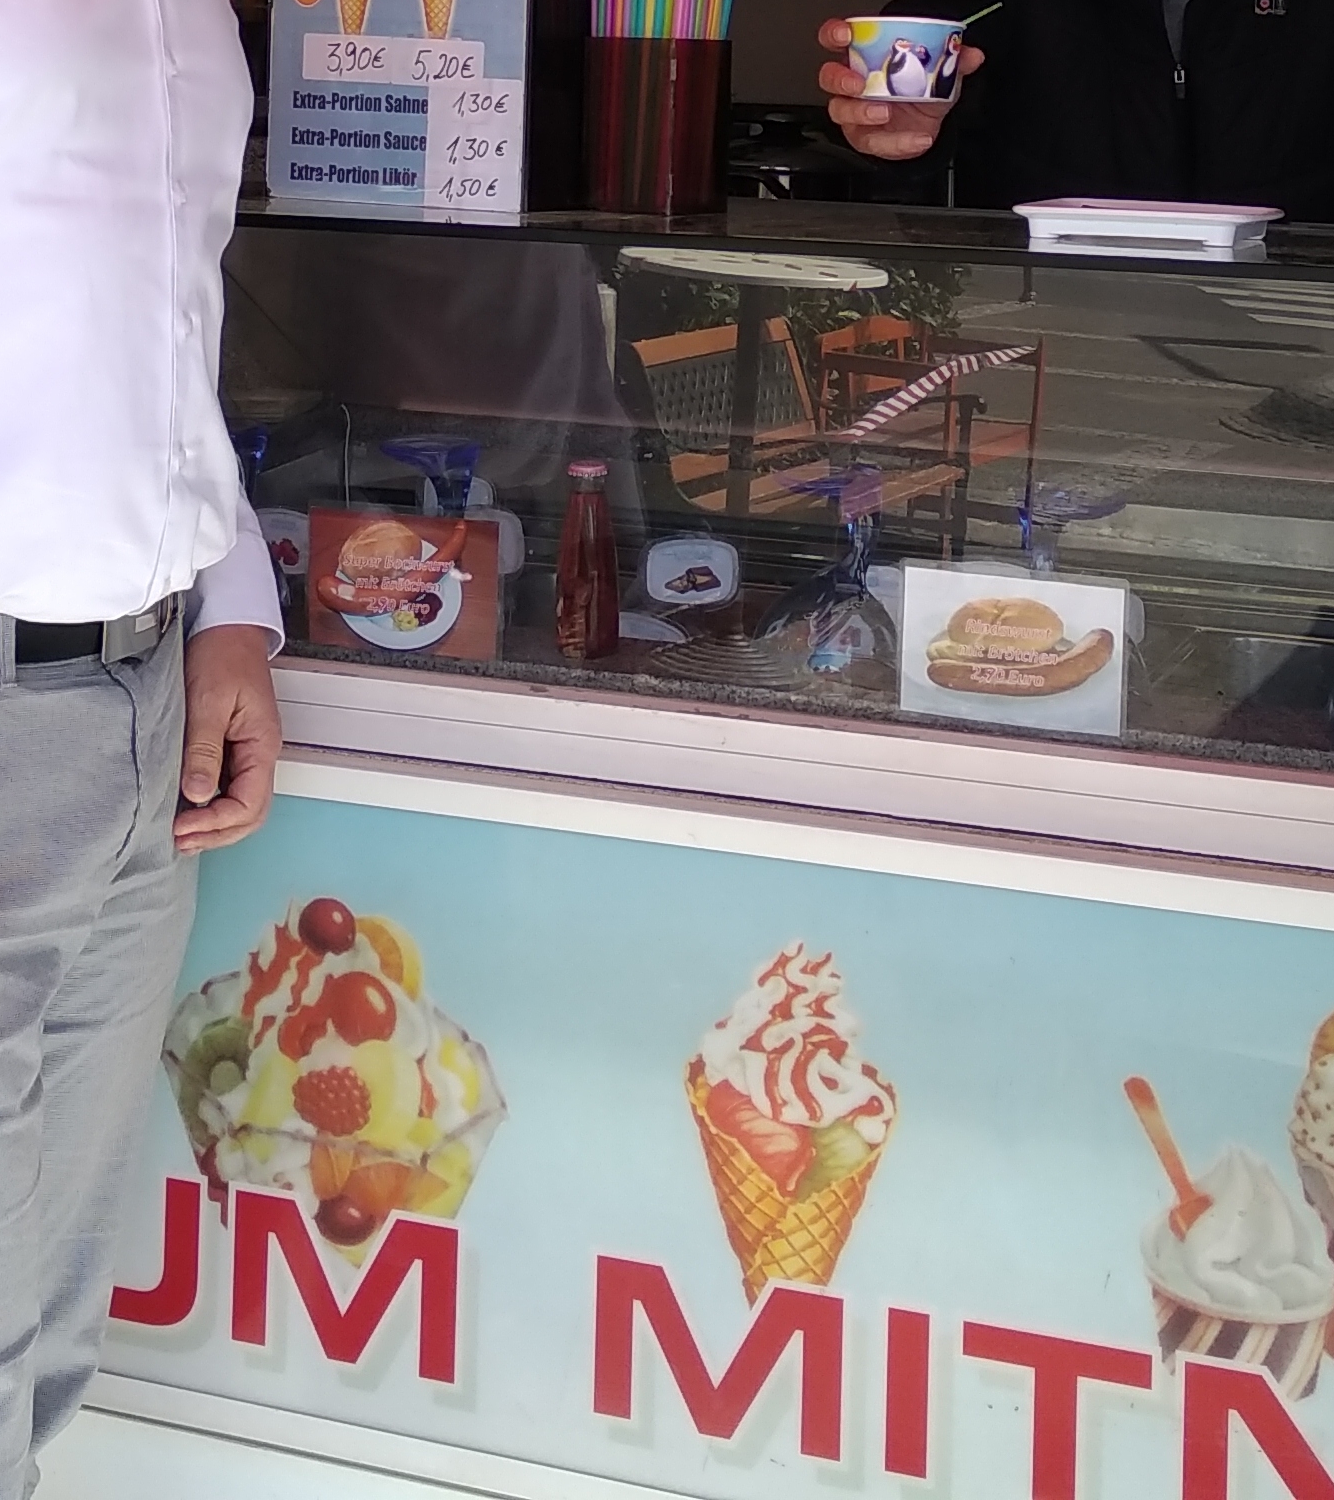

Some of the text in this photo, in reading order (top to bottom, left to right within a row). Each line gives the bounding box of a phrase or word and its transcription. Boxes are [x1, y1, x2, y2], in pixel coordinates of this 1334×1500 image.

[292, 90, 382, 114] Extra-Portion
[385, 94, 429, 115] Sahne
[290, 126, 381, 150] Extra-Portion
[383, 131, 427, 152] Sauce
[289, 162, 379, 186] Extra-Portion
[382, 167, 418, 188] Likör
[342, 553, 382, 570] Super
[964, 618, 1052, 640] Rindswurst
[987, 644, 1059, 665] Brötchen
[1008, 669, 1045, 688] Euro
